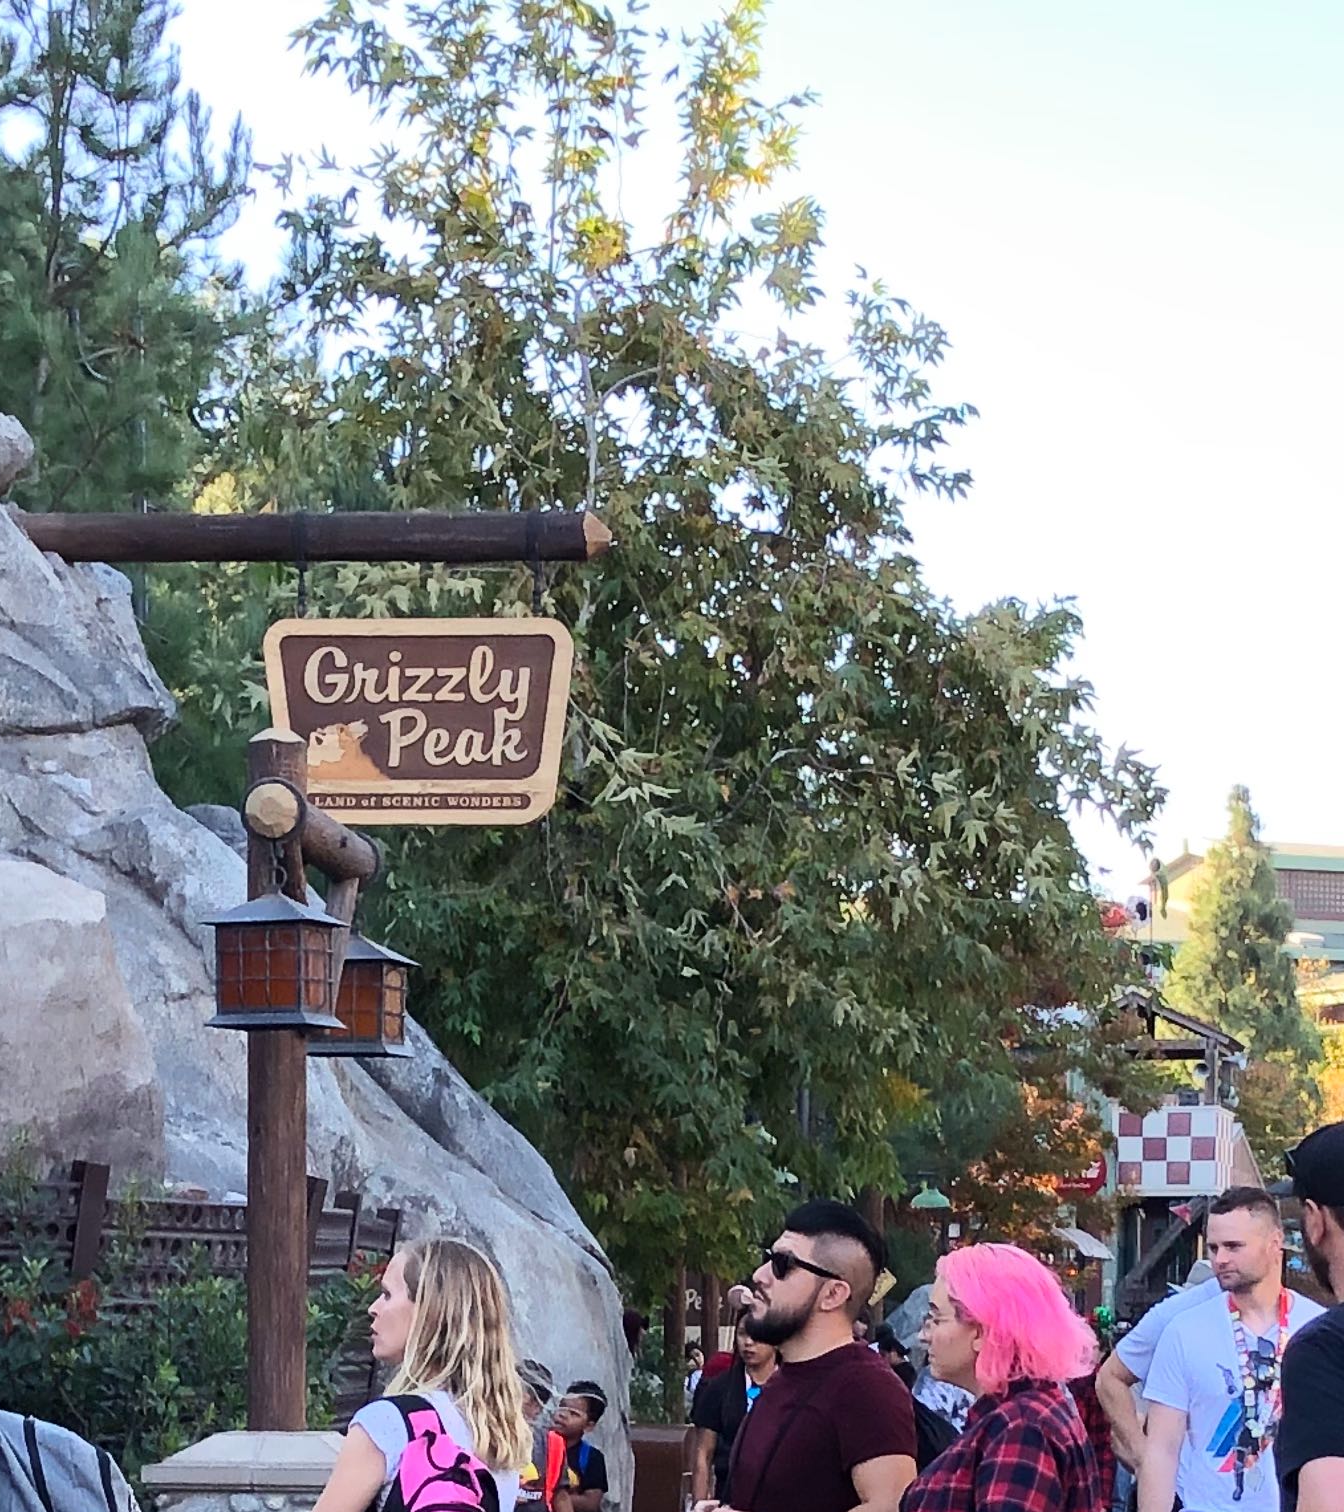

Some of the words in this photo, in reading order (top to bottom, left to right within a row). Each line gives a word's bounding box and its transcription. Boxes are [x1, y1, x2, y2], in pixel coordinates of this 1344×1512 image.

[303, 645, 531, 721] Grizzly
[378, 707, 528, 768] Peak
[314, 796, 356, 807] LAND
[361, 796, 376, 807] of
[382, 796, 440, 807] SCENIC
[447, 796, 522, 807] WONDERS
